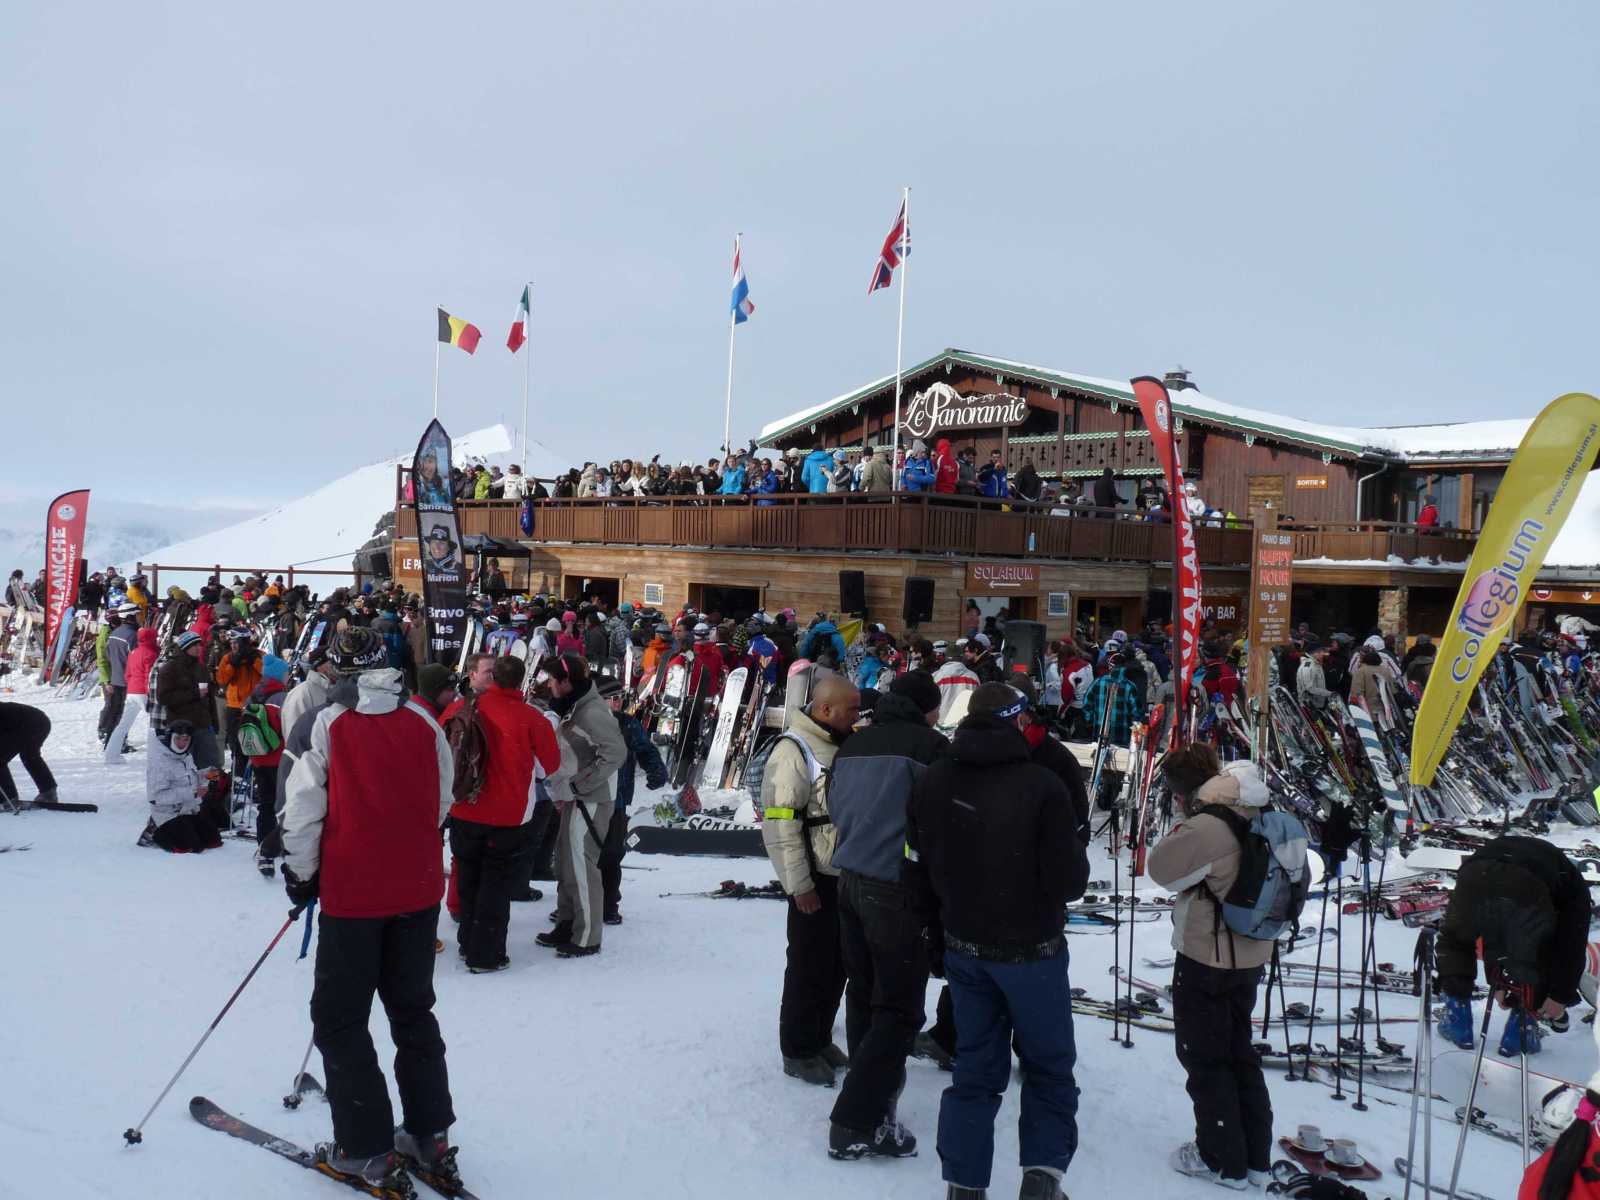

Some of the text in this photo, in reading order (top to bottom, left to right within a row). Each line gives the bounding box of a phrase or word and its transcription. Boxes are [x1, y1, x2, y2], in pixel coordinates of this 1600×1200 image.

[899, 382, 1026, 438] Le Panoramic
[1262, 534, 1291, 545] PANO BAR
[402, 558, 412, 570] LE
[427, 574, 459, 582] Marion
[974, 566, 1033, 580] SOLARIUM
[1452, 518, 1545, 683] Collegium
[428, 607, 464, 618] Bravo
[1217, 606, 1236, 620] BAR
[435, 622, 454, 634] les
[431, 638, 461, 651] filles
